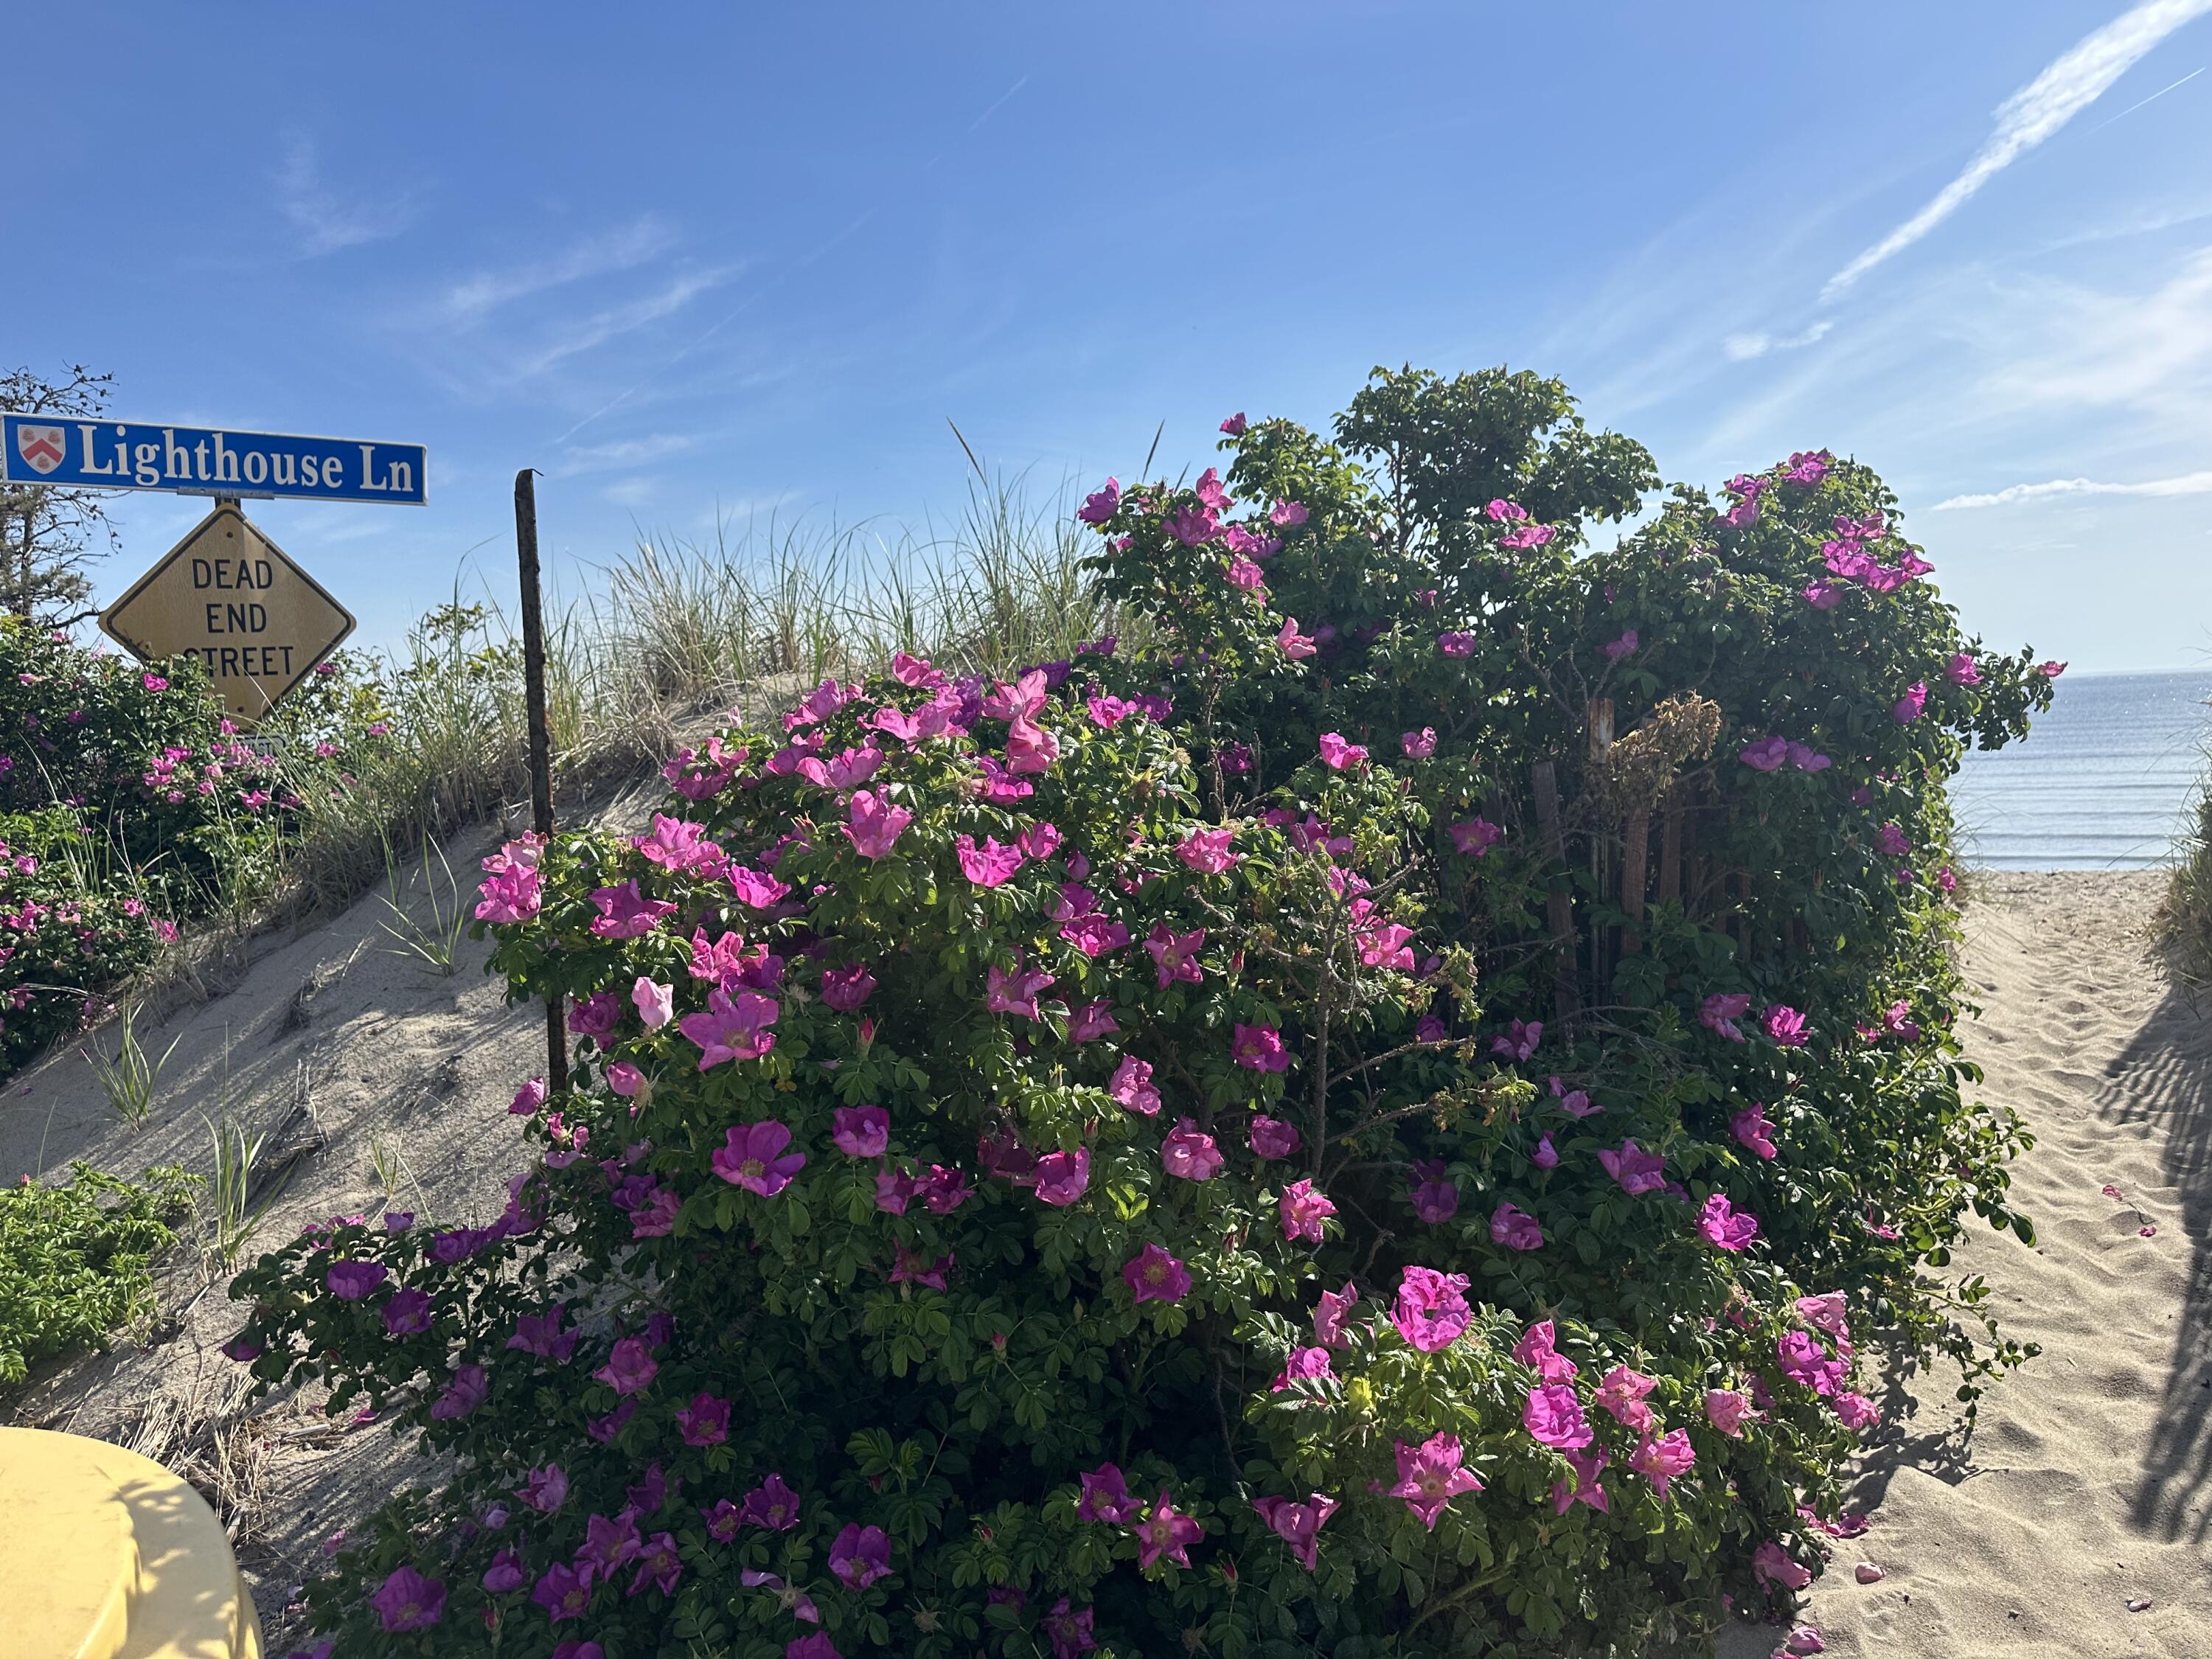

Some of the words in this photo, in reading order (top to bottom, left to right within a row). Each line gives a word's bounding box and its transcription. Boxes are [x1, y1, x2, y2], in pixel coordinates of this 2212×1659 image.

[77, 424, 343, 487] Lighthouse
[358, 445, 414, 492] Ln
[192, 558, 273, 590] DEAD
[206, 603, 267, 634] END
